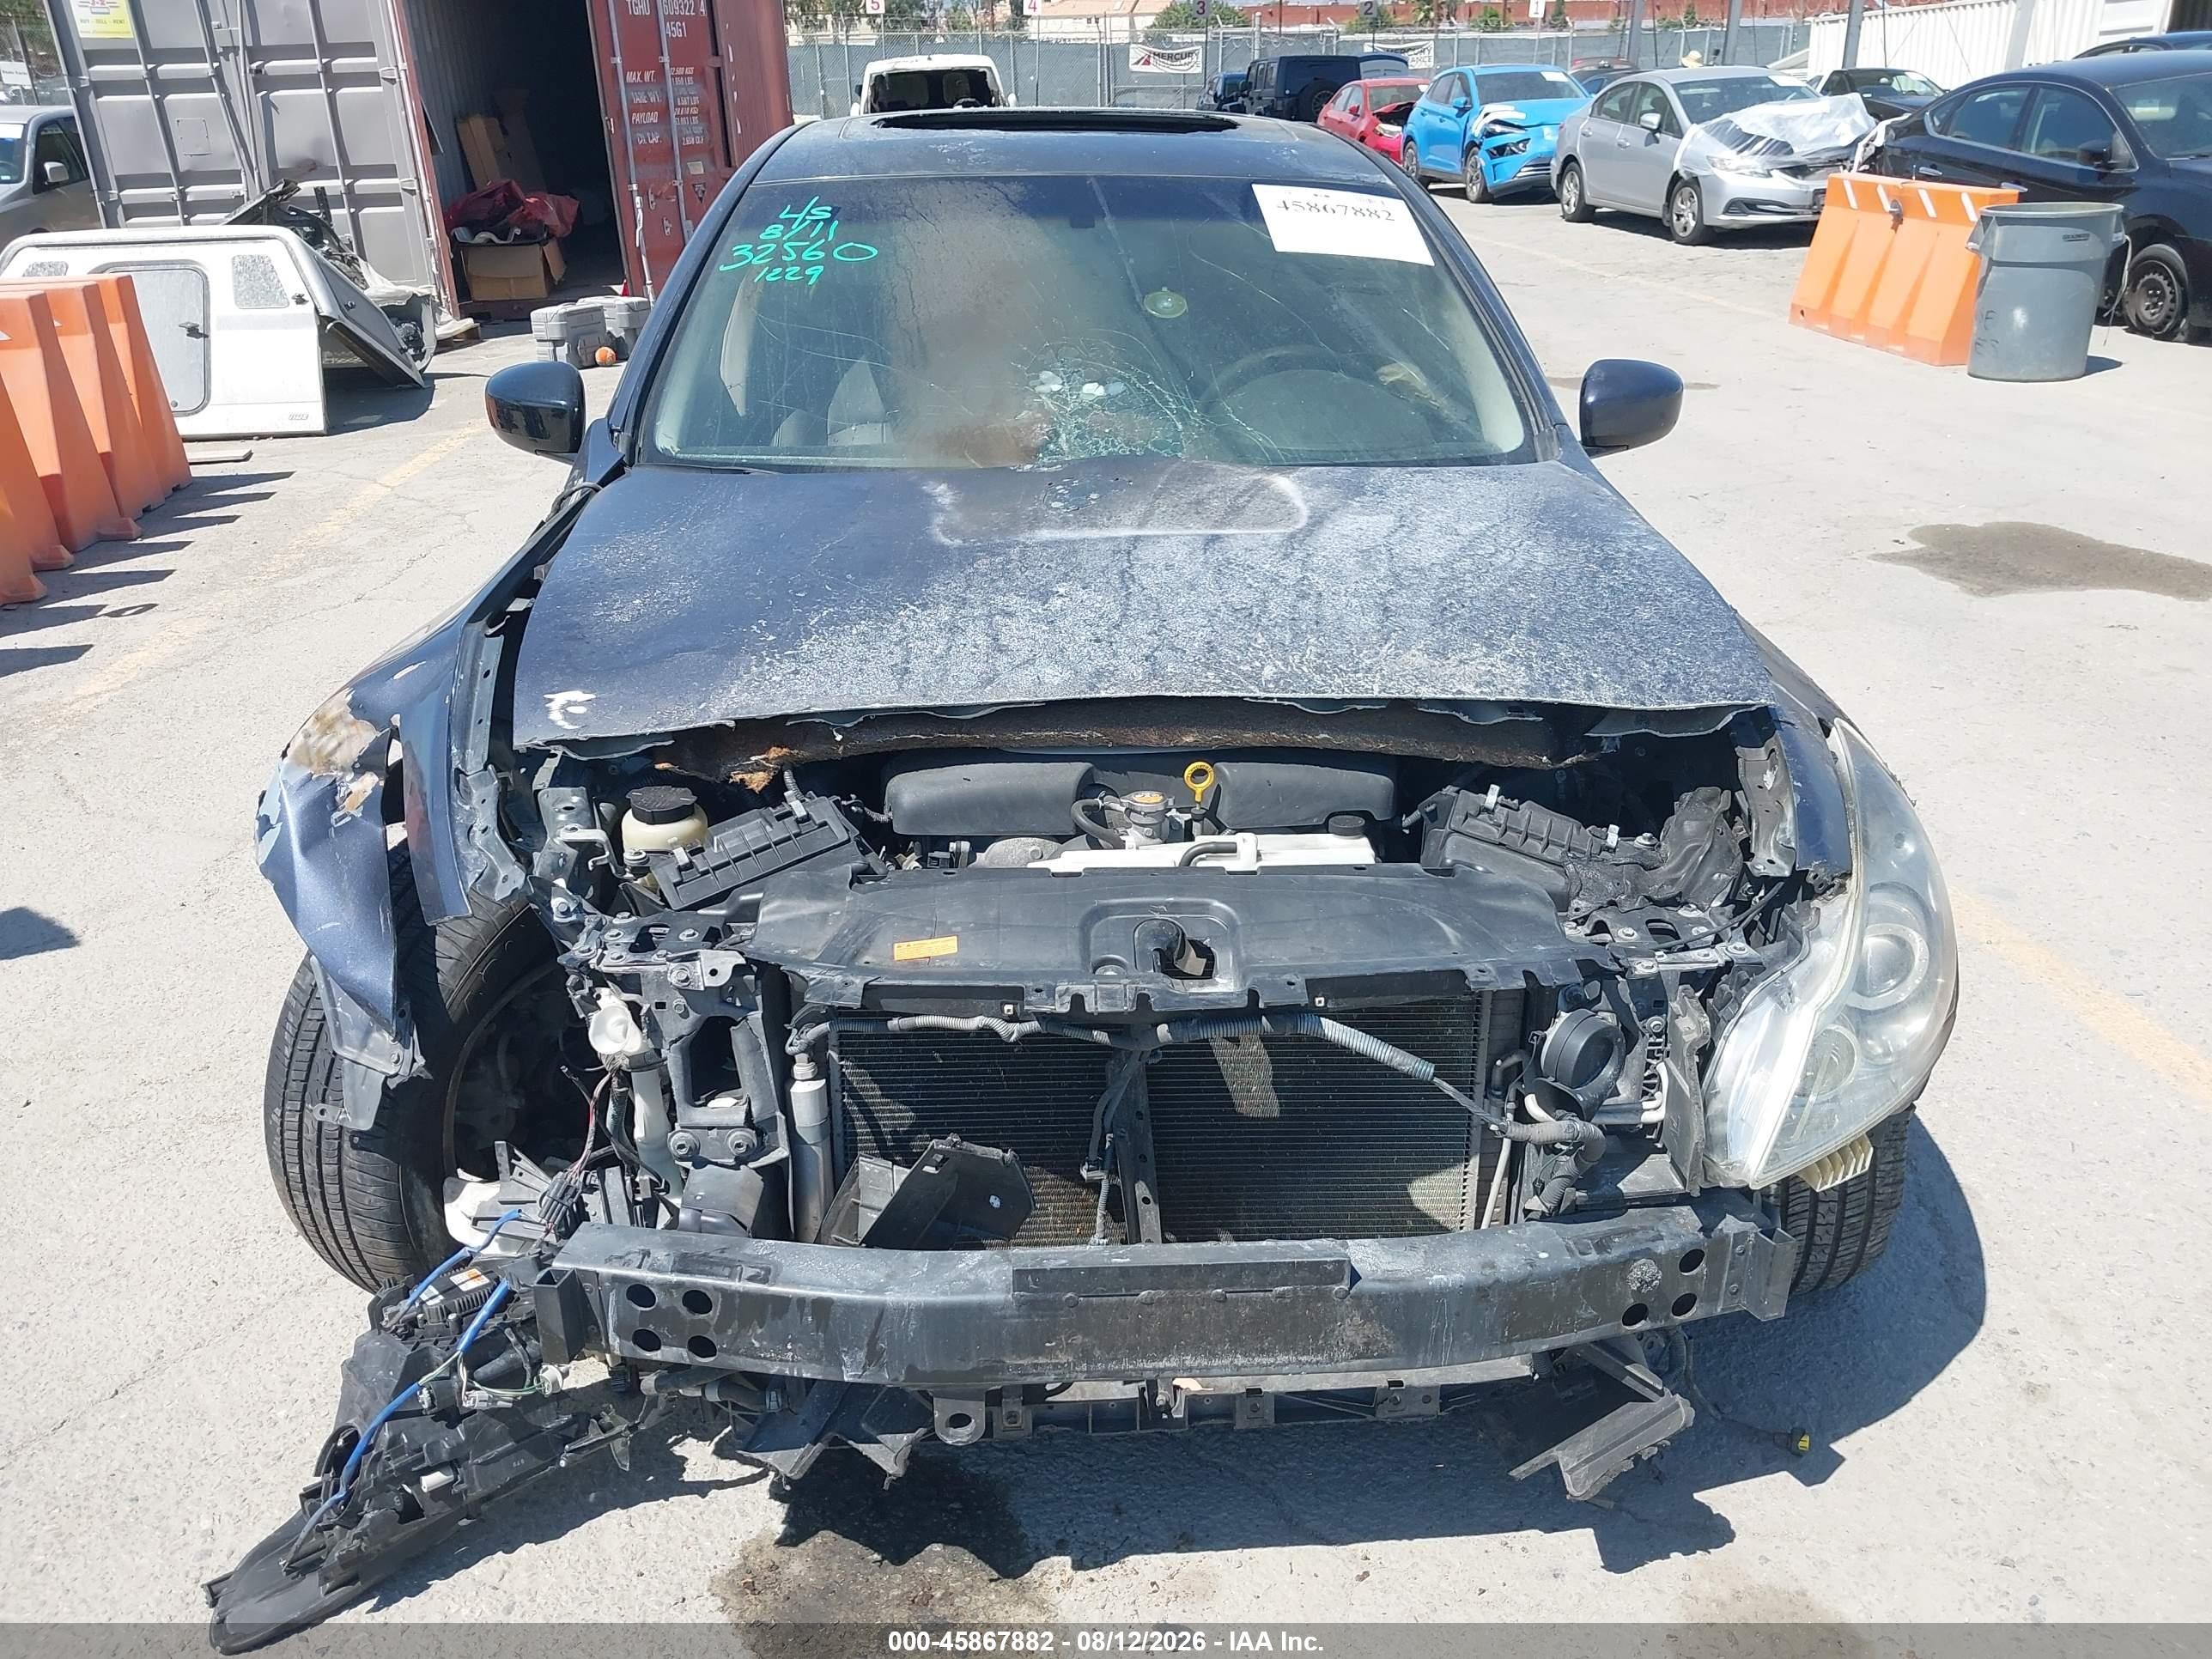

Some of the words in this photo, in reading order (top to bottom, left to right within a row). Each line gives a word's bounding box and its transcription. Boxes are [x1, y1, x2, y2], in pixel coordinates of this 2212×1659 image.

[626, 0, 651, 15] TGHU
[871, 0, 881, 10] 5
[1028, 0, 1038, 13] 4
[1196, 1, 1206, 15] 3
[1364, 1, 1374, 15] 2
[665, 21, 688, 38] 45G1
[631, 111, 659, 125] PAYLOAD
[1278, 200, 1395, 222] 45867882
